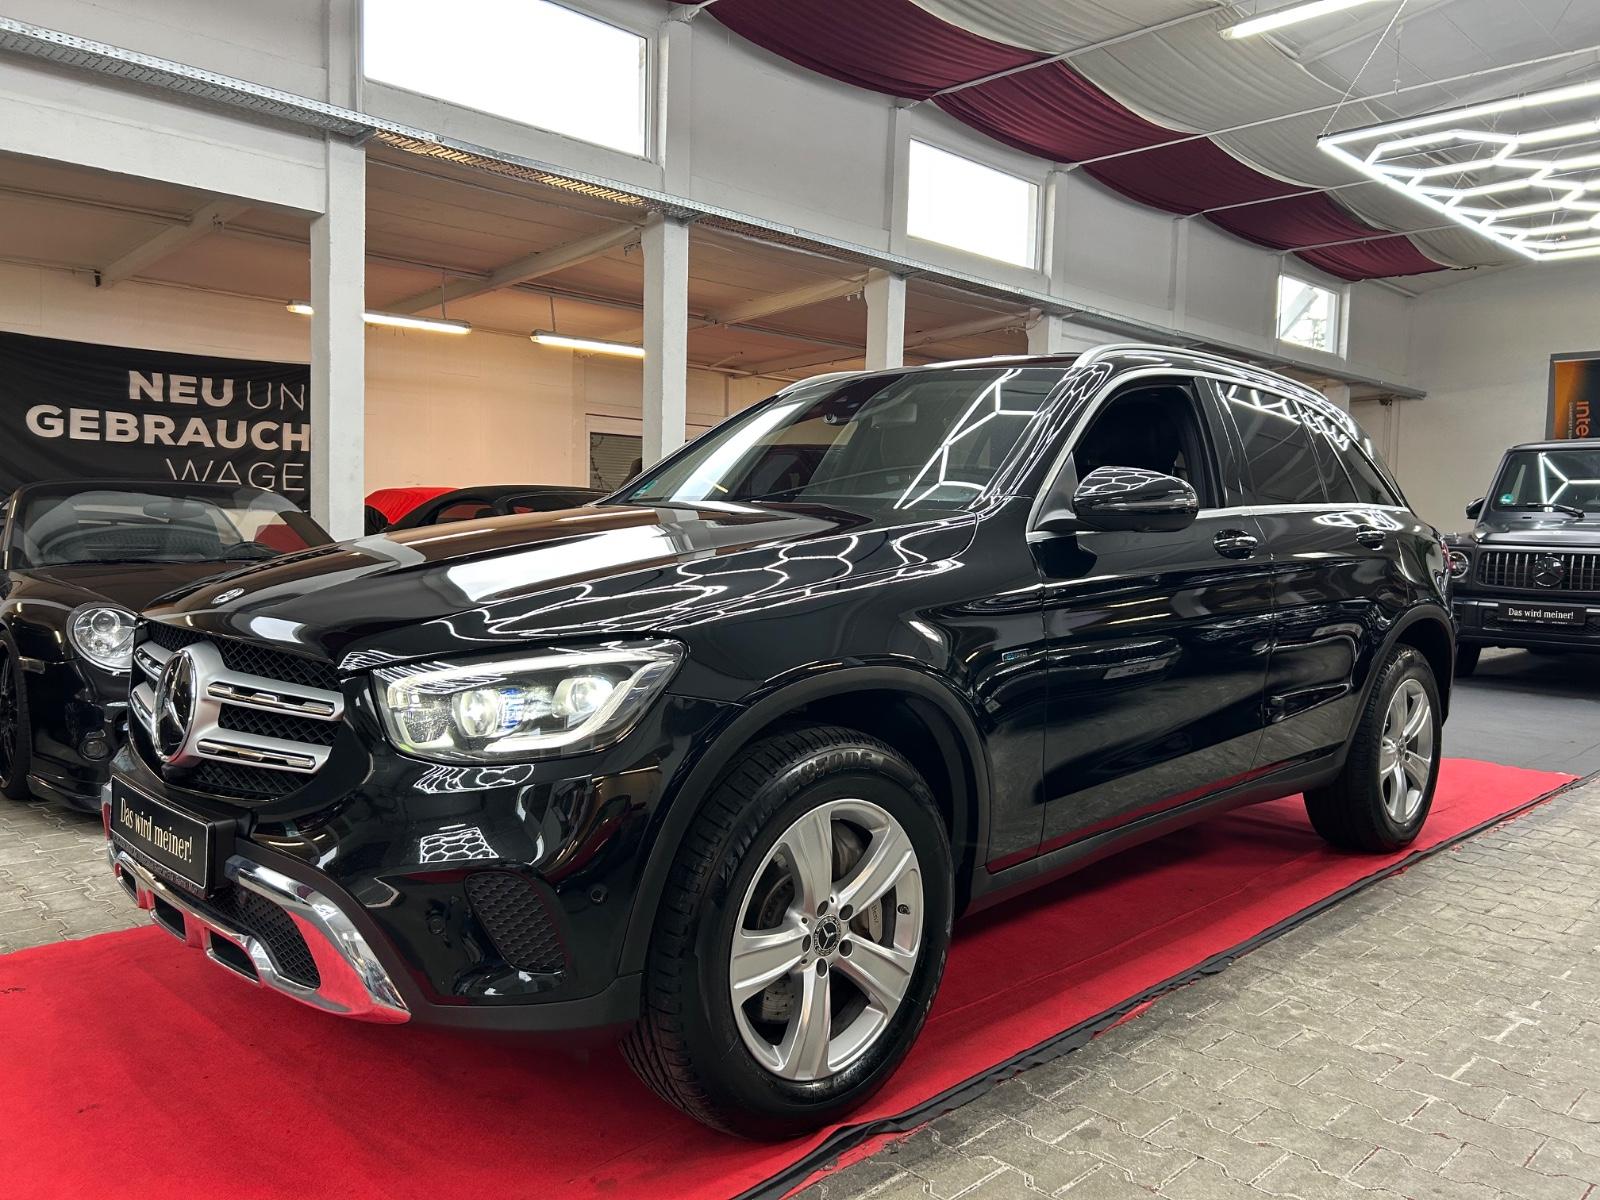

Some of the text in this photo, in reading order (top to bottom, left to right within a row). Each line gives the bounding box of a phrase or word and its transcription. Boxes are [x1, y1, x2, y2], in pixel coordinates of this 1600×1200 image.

[128, 370, 305, 411] NEU UN
[25, 404, 311, 452] GEBRAUCH
[165, 458, 305, 491] WAGE
[1508, 607, 1574, 620] Das wird meiner!
[120, 797, 193, 864] Das wird meiner!
